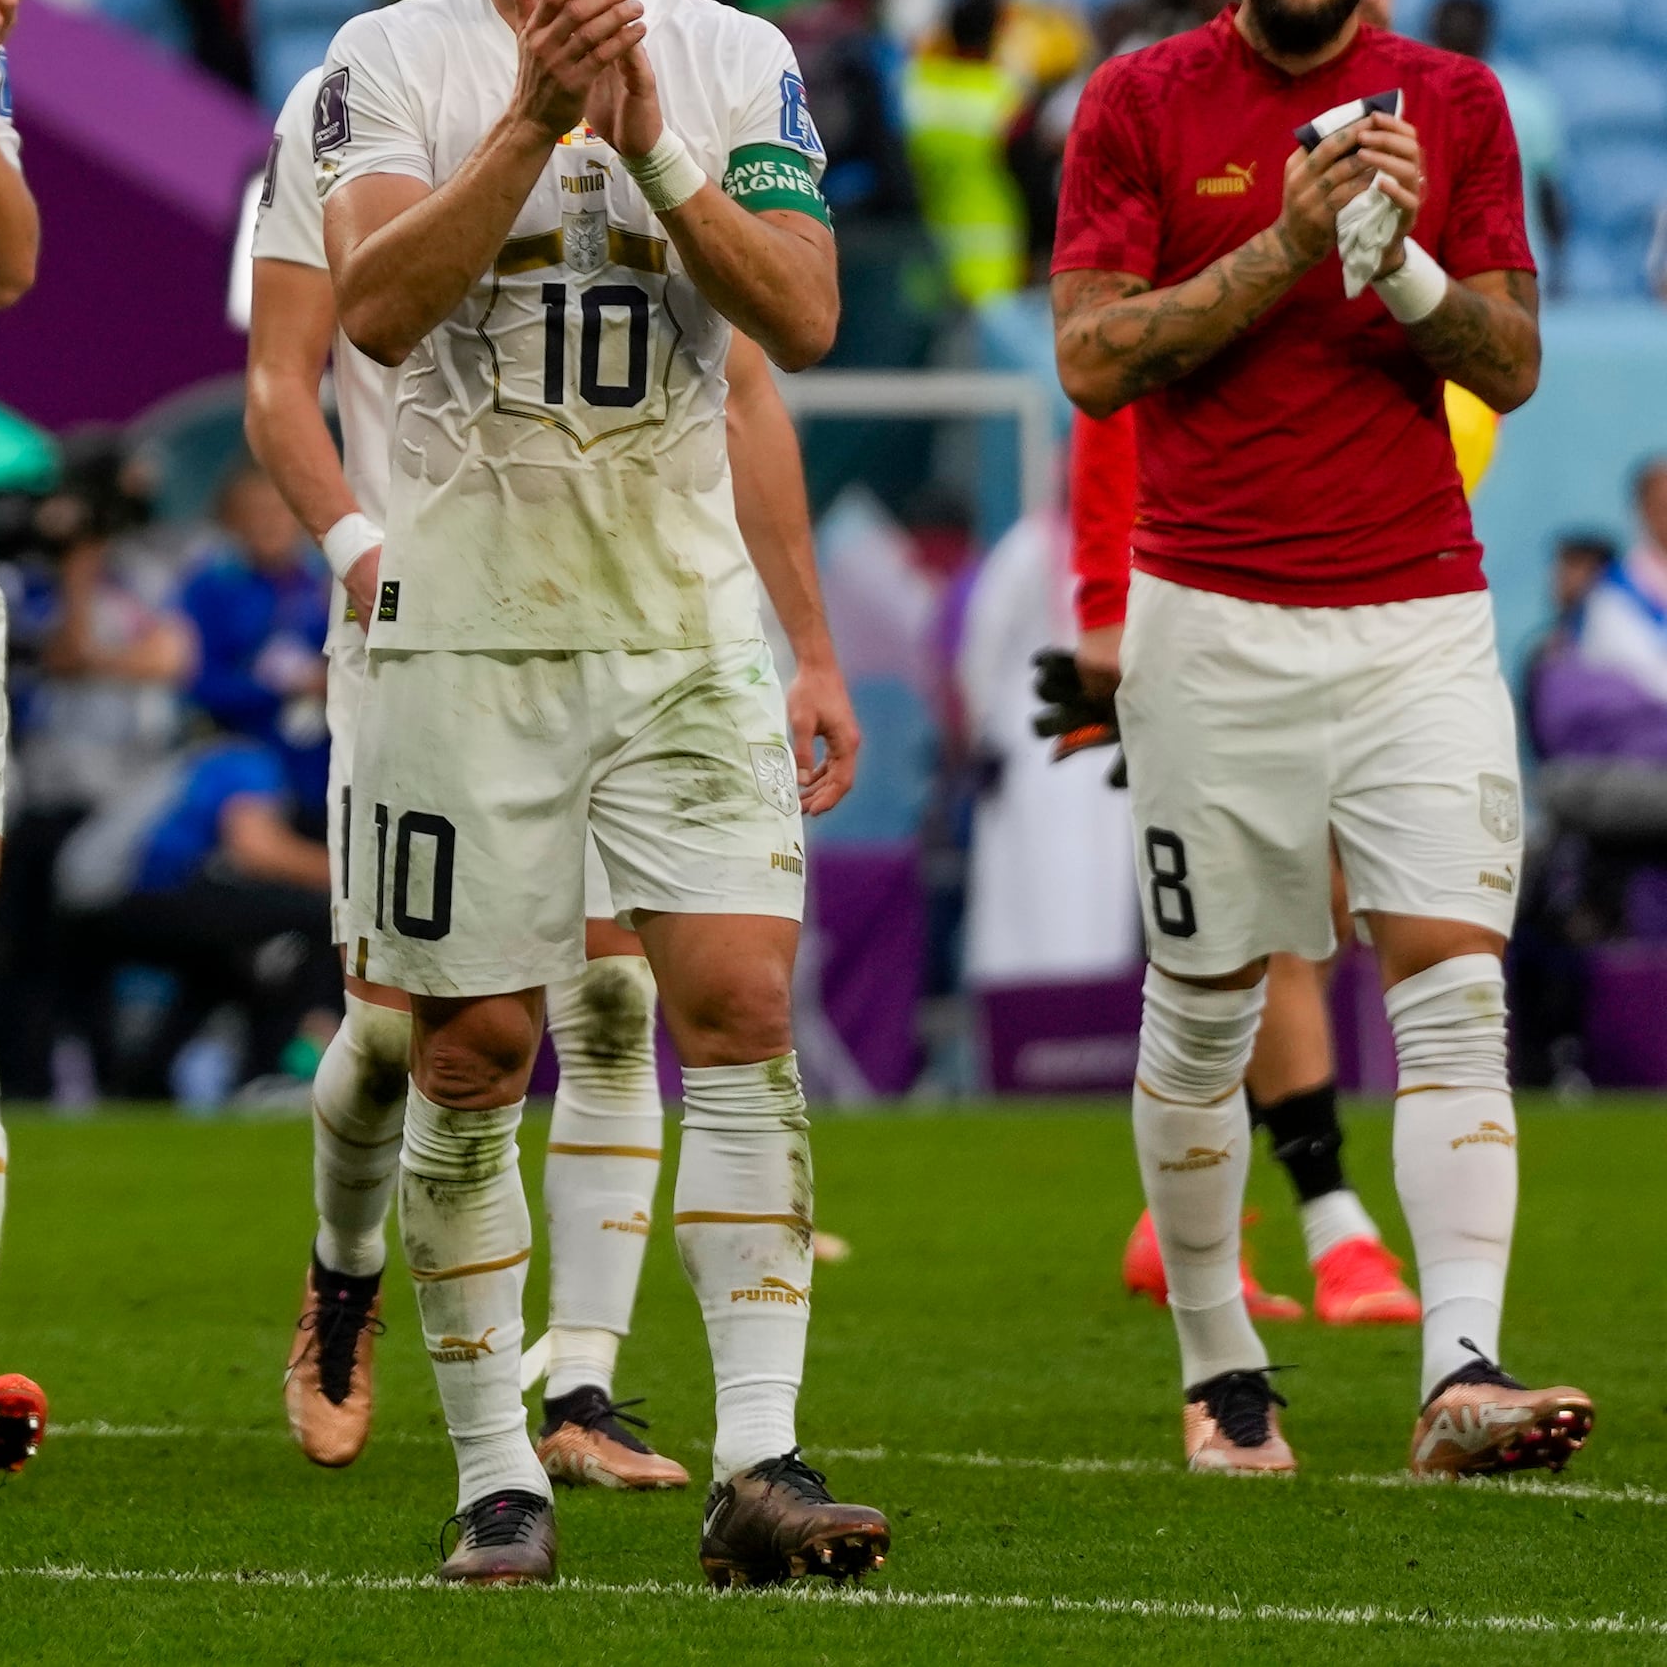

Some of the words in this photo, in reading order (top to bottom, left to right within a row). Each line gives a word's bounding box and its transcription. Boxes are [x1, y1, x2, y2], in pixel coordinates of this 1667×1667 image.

[560, 173, 605, 194] PUMA
[723, 160, 778, 189] SAVE
[1196, 176, 1246, 195] PUMA
[541, 282, 650, 408] 10
[375, 803, 456, 941] 10
[1145, 825, 1197, 939] 8
[730, 1289, 798, 1305] PUMA
